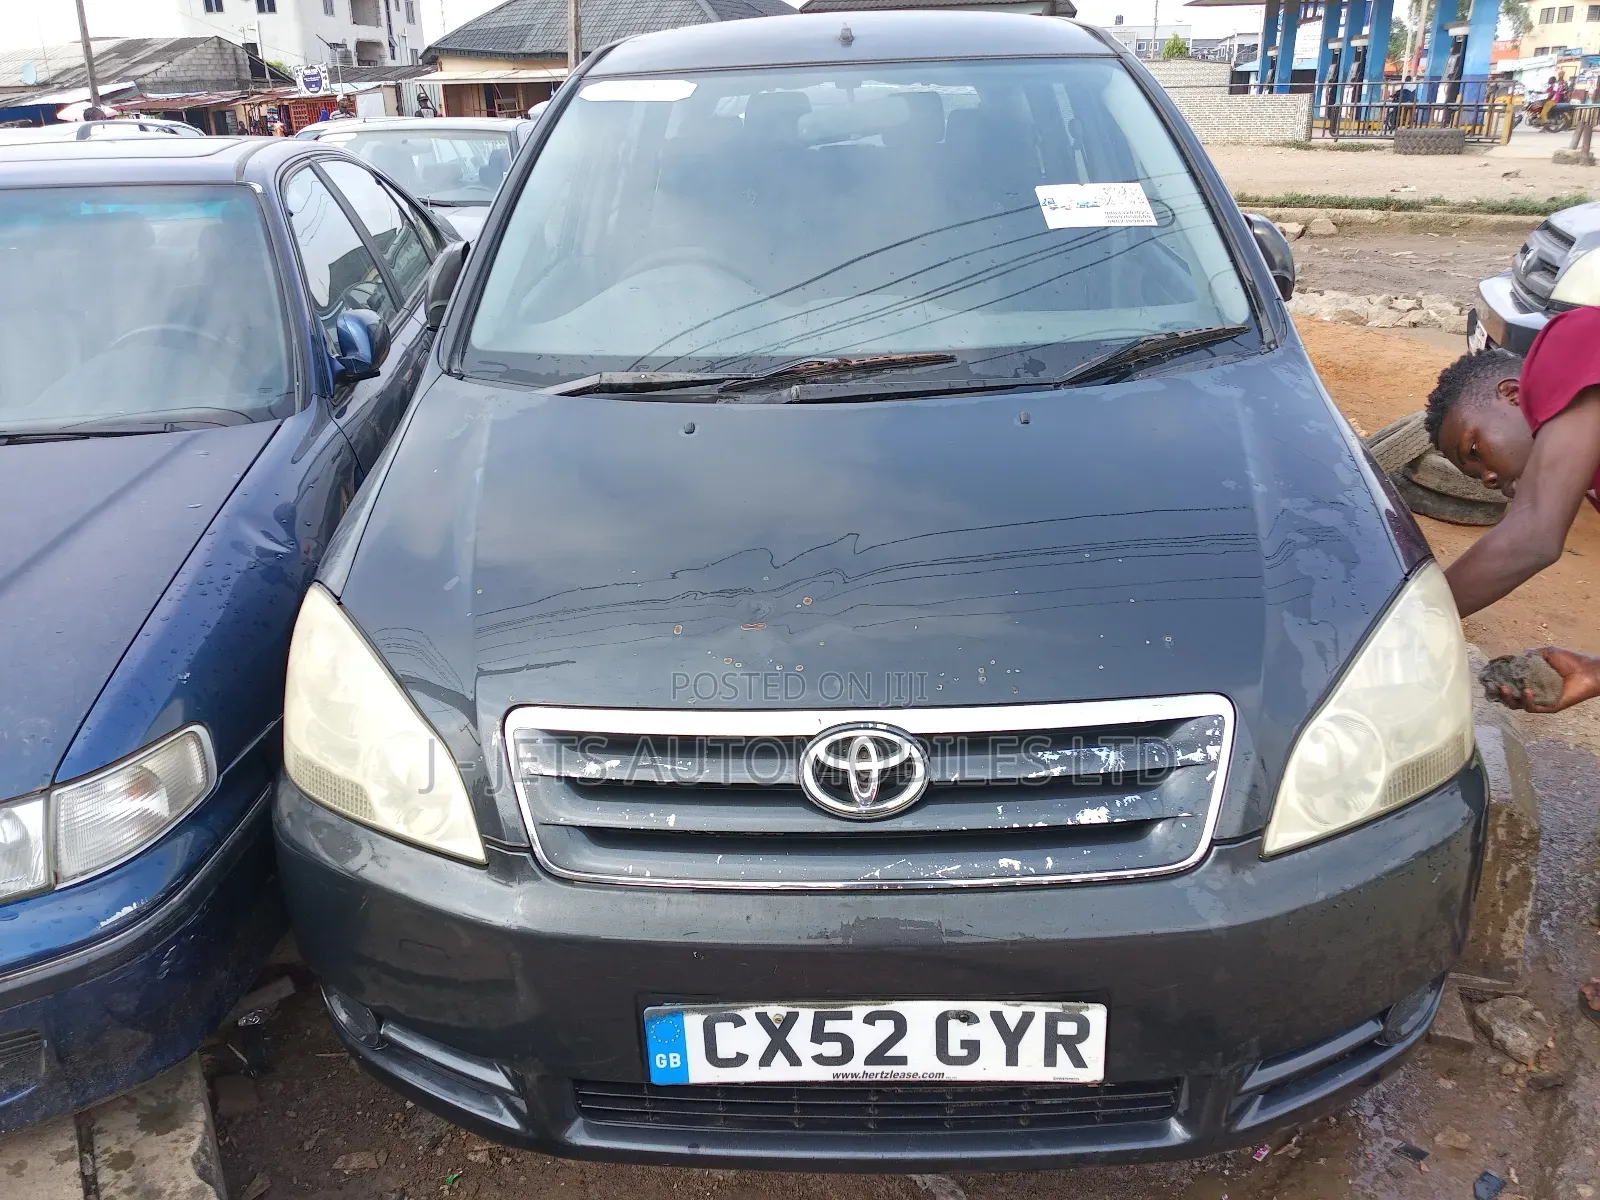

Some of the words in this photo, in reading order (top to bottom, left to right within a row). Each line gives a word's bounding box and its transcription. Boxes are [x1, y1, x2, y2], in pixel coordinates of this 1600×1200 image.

[703, 1010, 908, 1068] CX52
[935, 1010, 1091, 1069] GYR
[654, 1053, 682, 1069] GB
[832, 1069, 945, 1080] www.hertzlease.com
